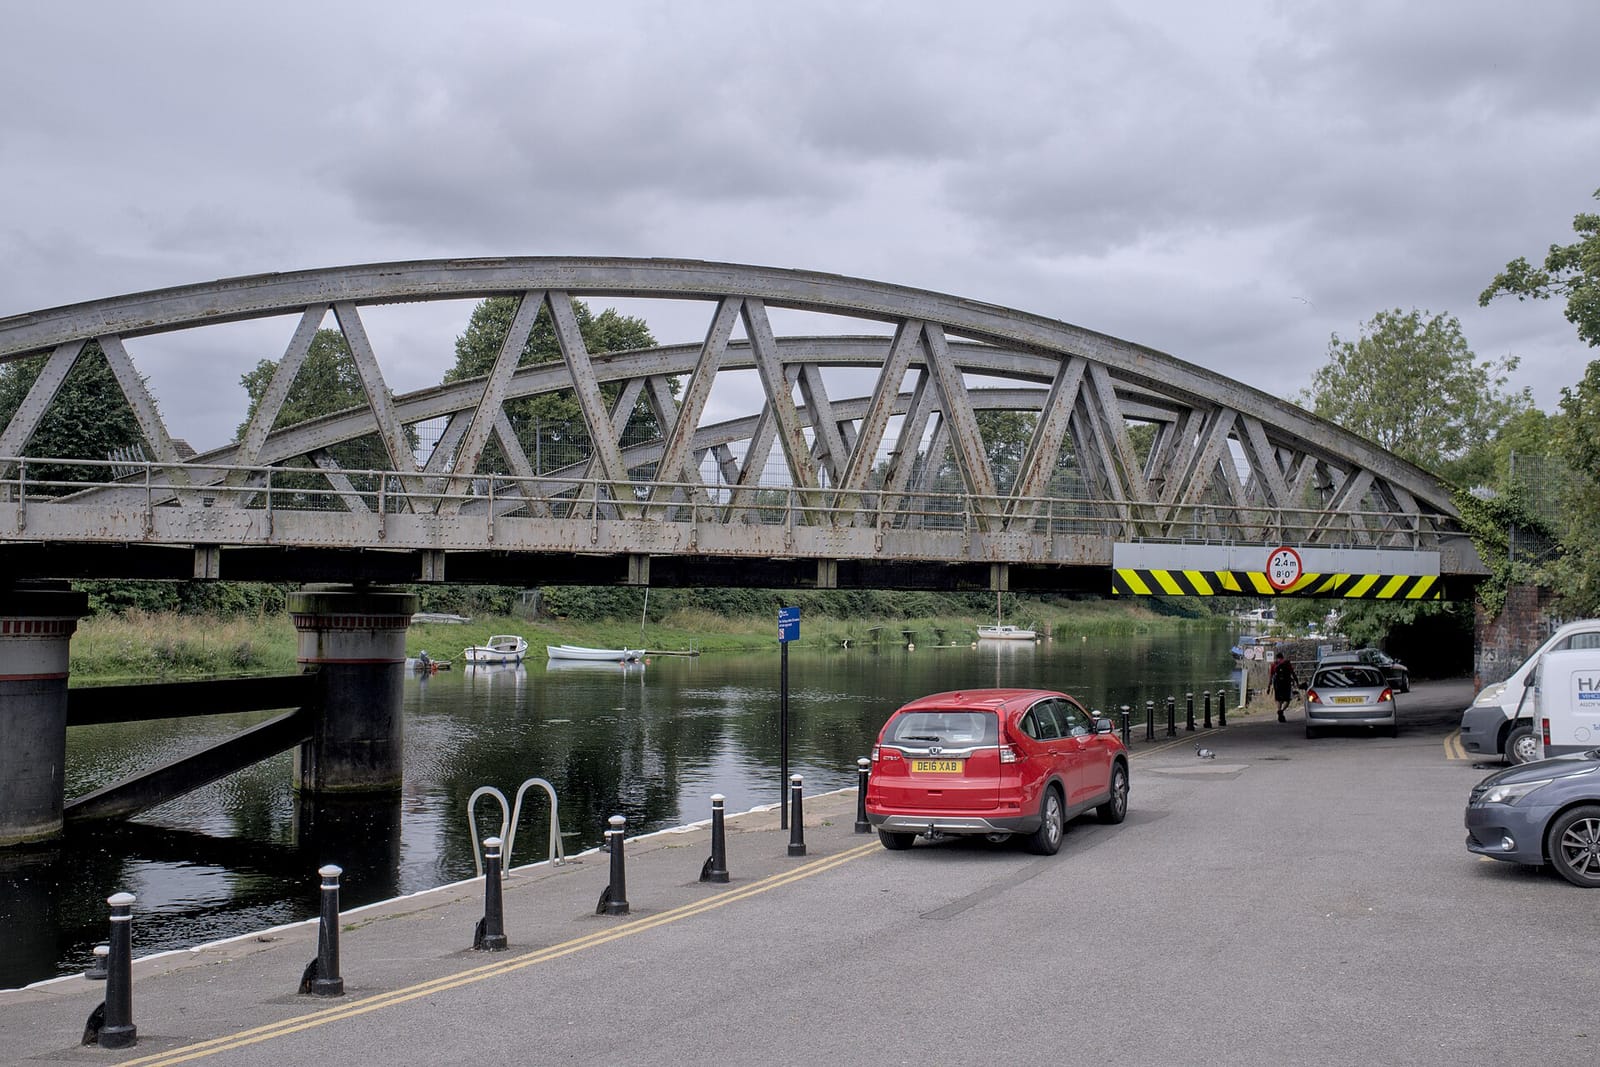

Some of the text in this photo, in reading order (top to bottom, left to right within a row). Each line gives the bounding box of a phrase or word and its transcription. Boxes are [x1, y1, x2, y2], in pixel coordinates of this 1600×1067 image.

[1275, 558, 1288, 566] 2.4
[917, 761, 957, 771] DE16 XAB
